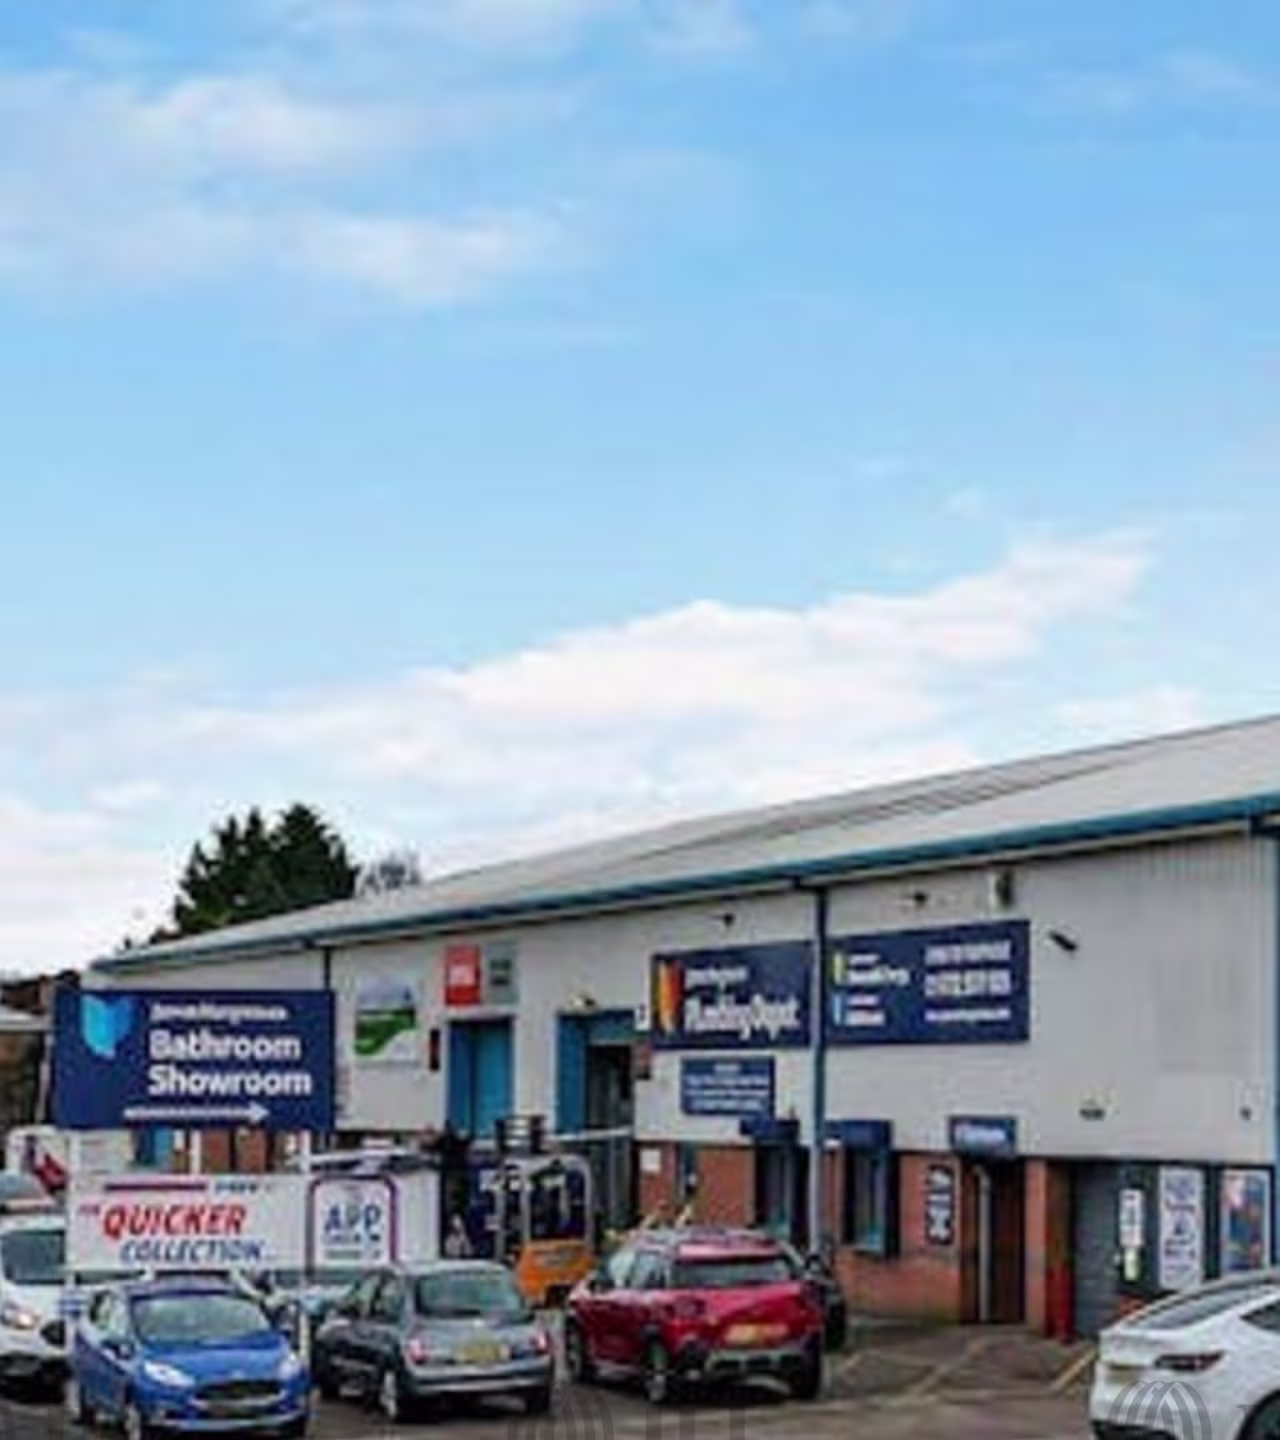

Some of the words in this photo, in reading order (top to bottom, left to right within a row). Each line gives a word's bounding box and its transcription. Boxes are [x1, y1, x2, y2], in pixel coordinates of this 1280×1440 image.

[149, 1028, 301, 1061] Bathroom
[148, 1063, 313, 1096] Showroom
[103, 1204, 248, 1241] QUICKER
[120, 1239, 267, 1263] COLLECTION
